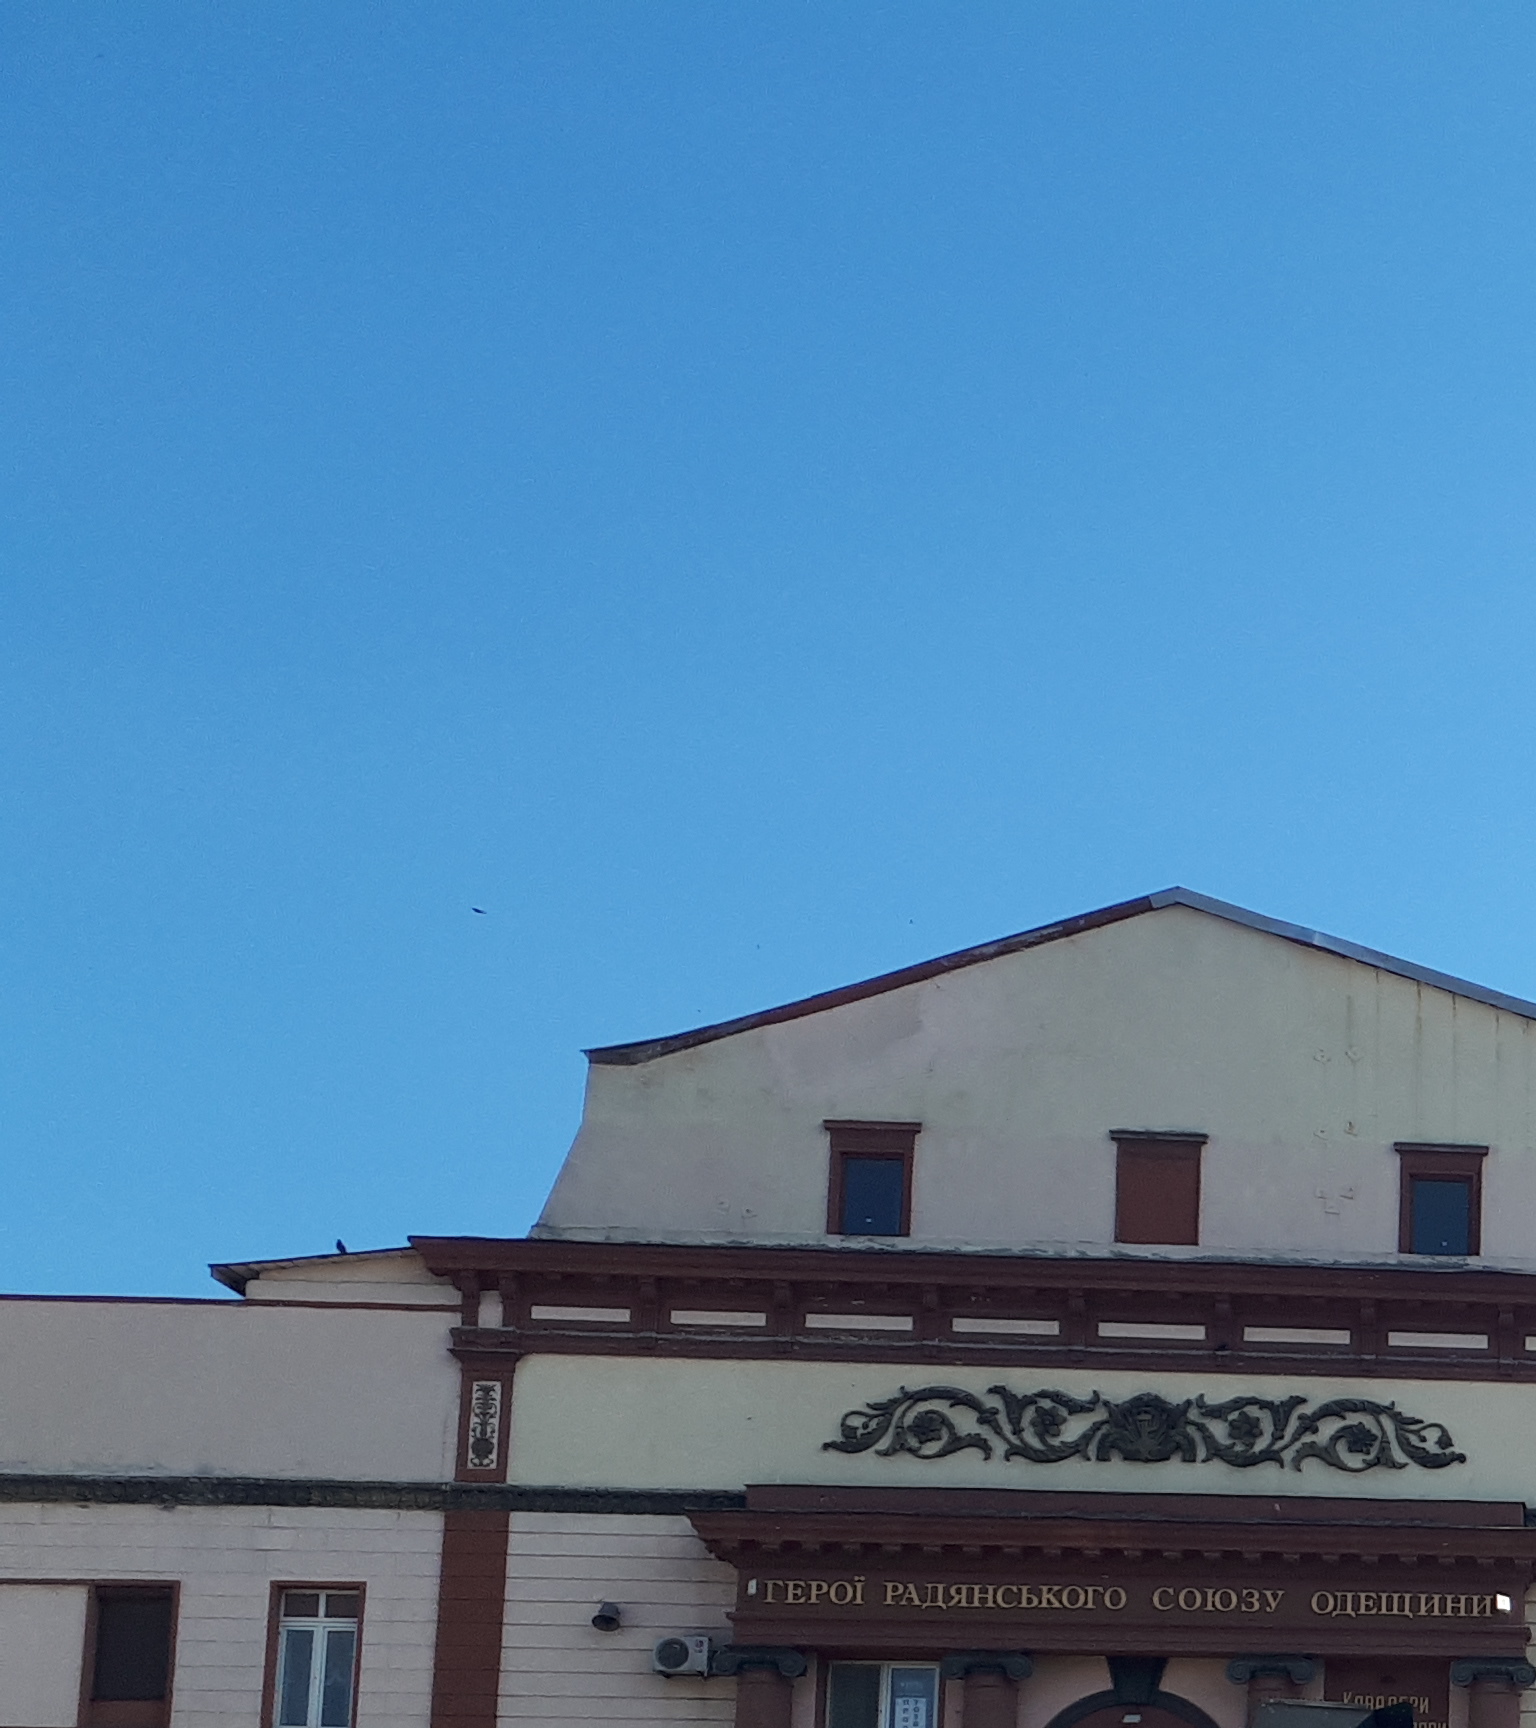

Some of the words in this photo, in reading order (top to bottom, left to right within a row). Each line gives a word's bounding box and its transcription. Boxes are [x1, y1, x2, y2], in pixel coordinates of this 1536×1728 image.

[764, 1577, 866, 1605] ГЕРОЇ
[884, 1582, 1127, 1611] РАДЯНСЬКОГО
[1153, 1587, 1285, 1613] СОЮЗУ
[1311, 1591, 1496, 1619] ОДЕЩИНИ
